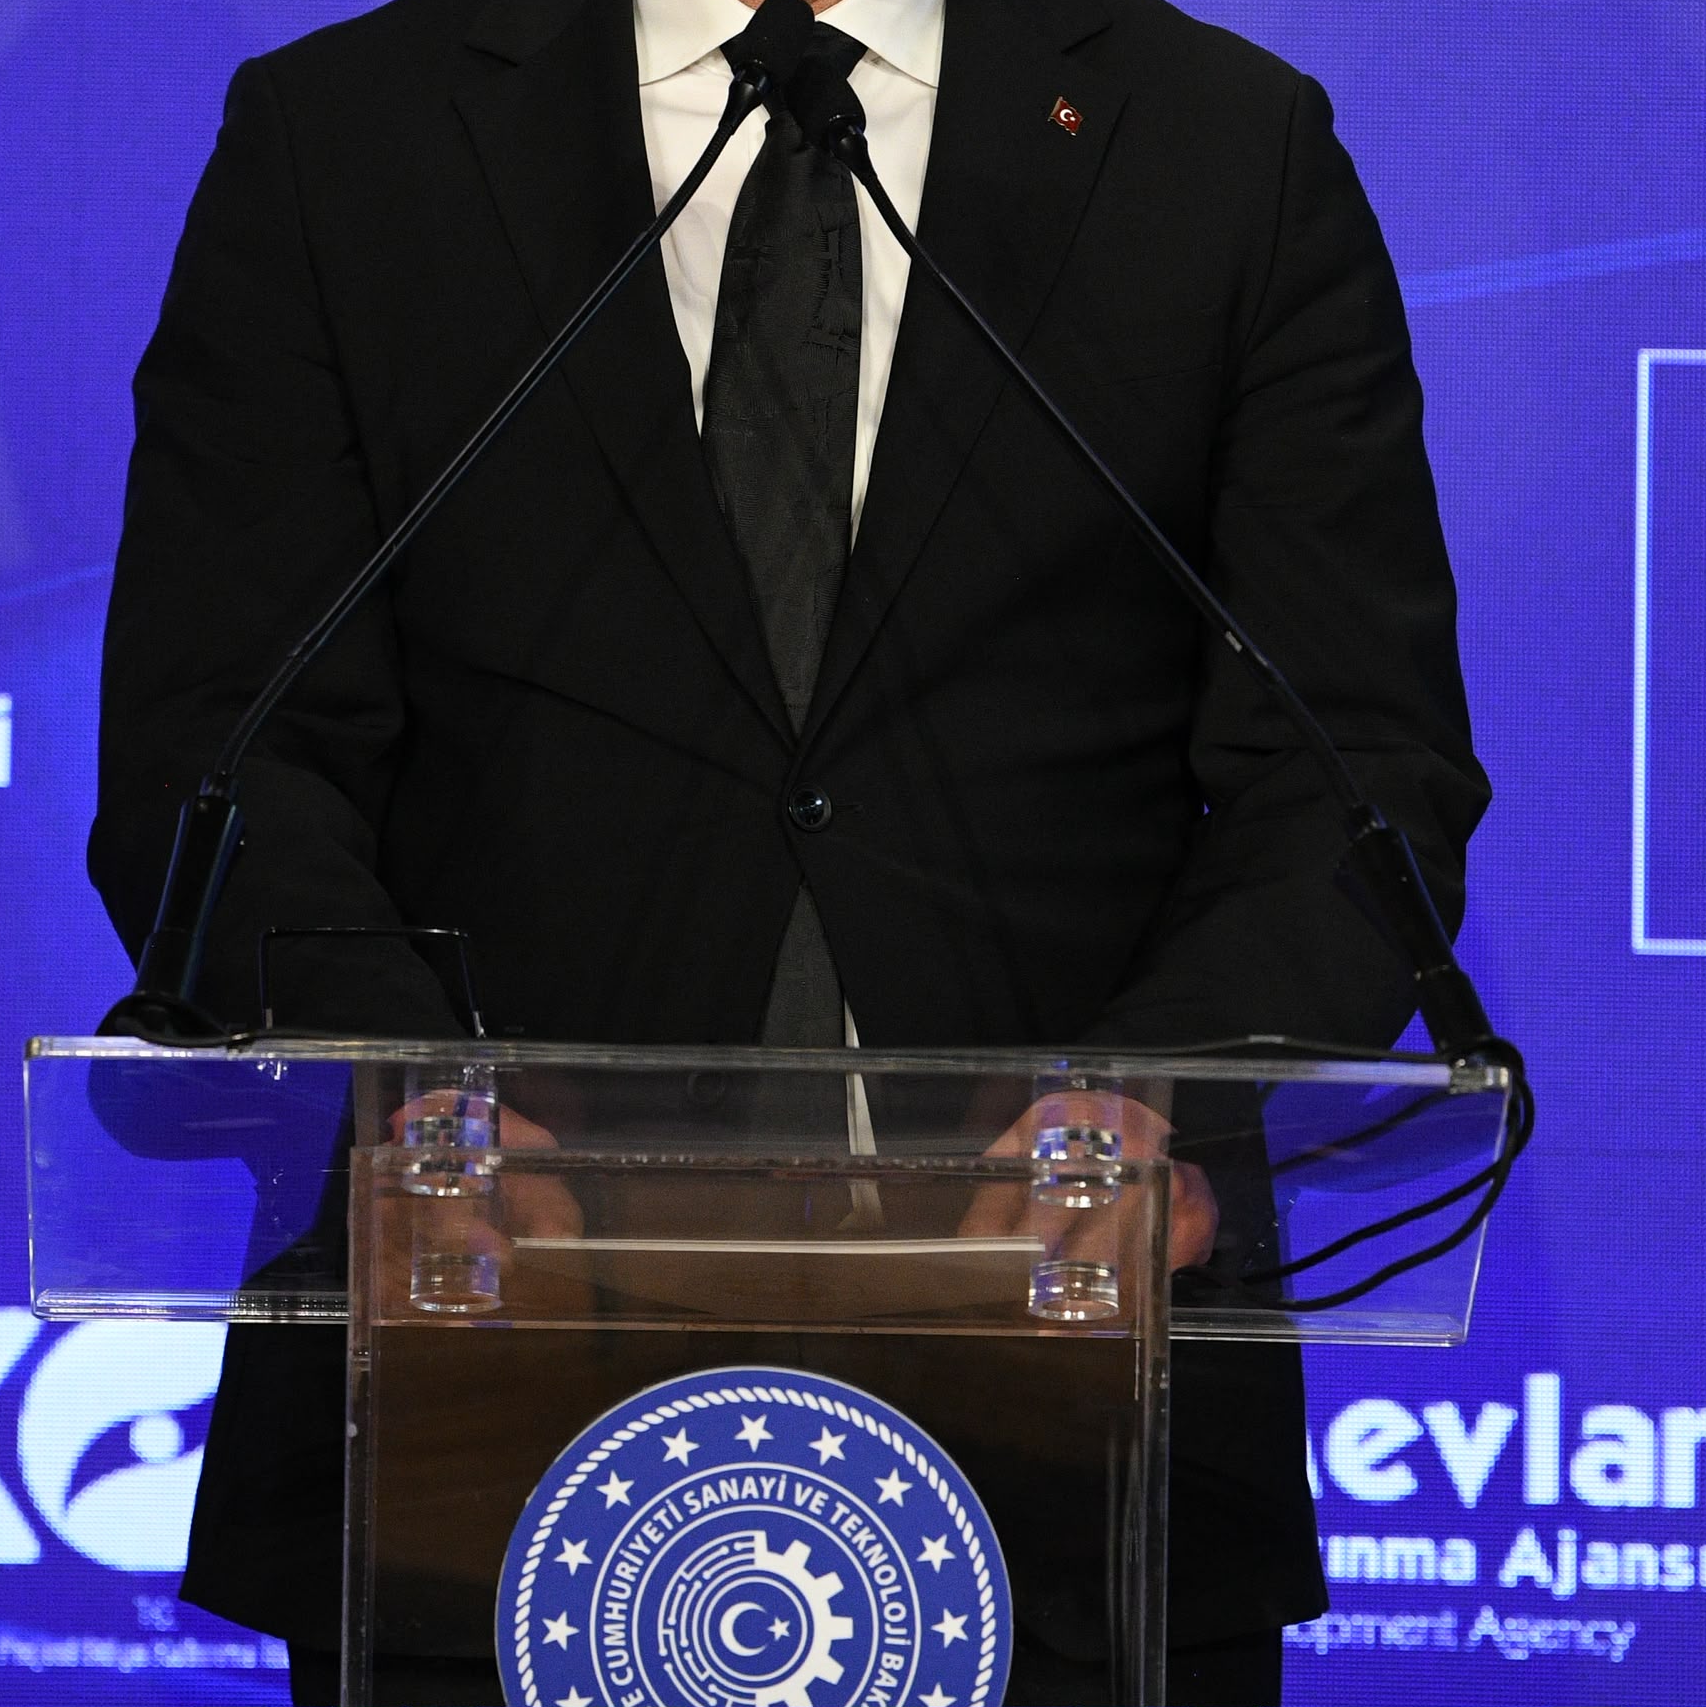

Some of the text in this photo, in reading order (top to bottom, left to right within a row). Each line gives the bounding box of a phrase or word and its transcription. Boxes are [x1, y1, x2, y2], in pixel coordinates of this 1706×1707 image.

[604, 1499, 684, 1686] CUMHURİYETİ
[683, 1473, 786, 1515] SANAYİ
[794, 1482, 831, 1515] VE
[829, 1502, 912, 1646] TEKNOLOJİ
[1319, 1536, 1476, 1584] ınma
[1469, 1607, 1635, 1661] Agency
